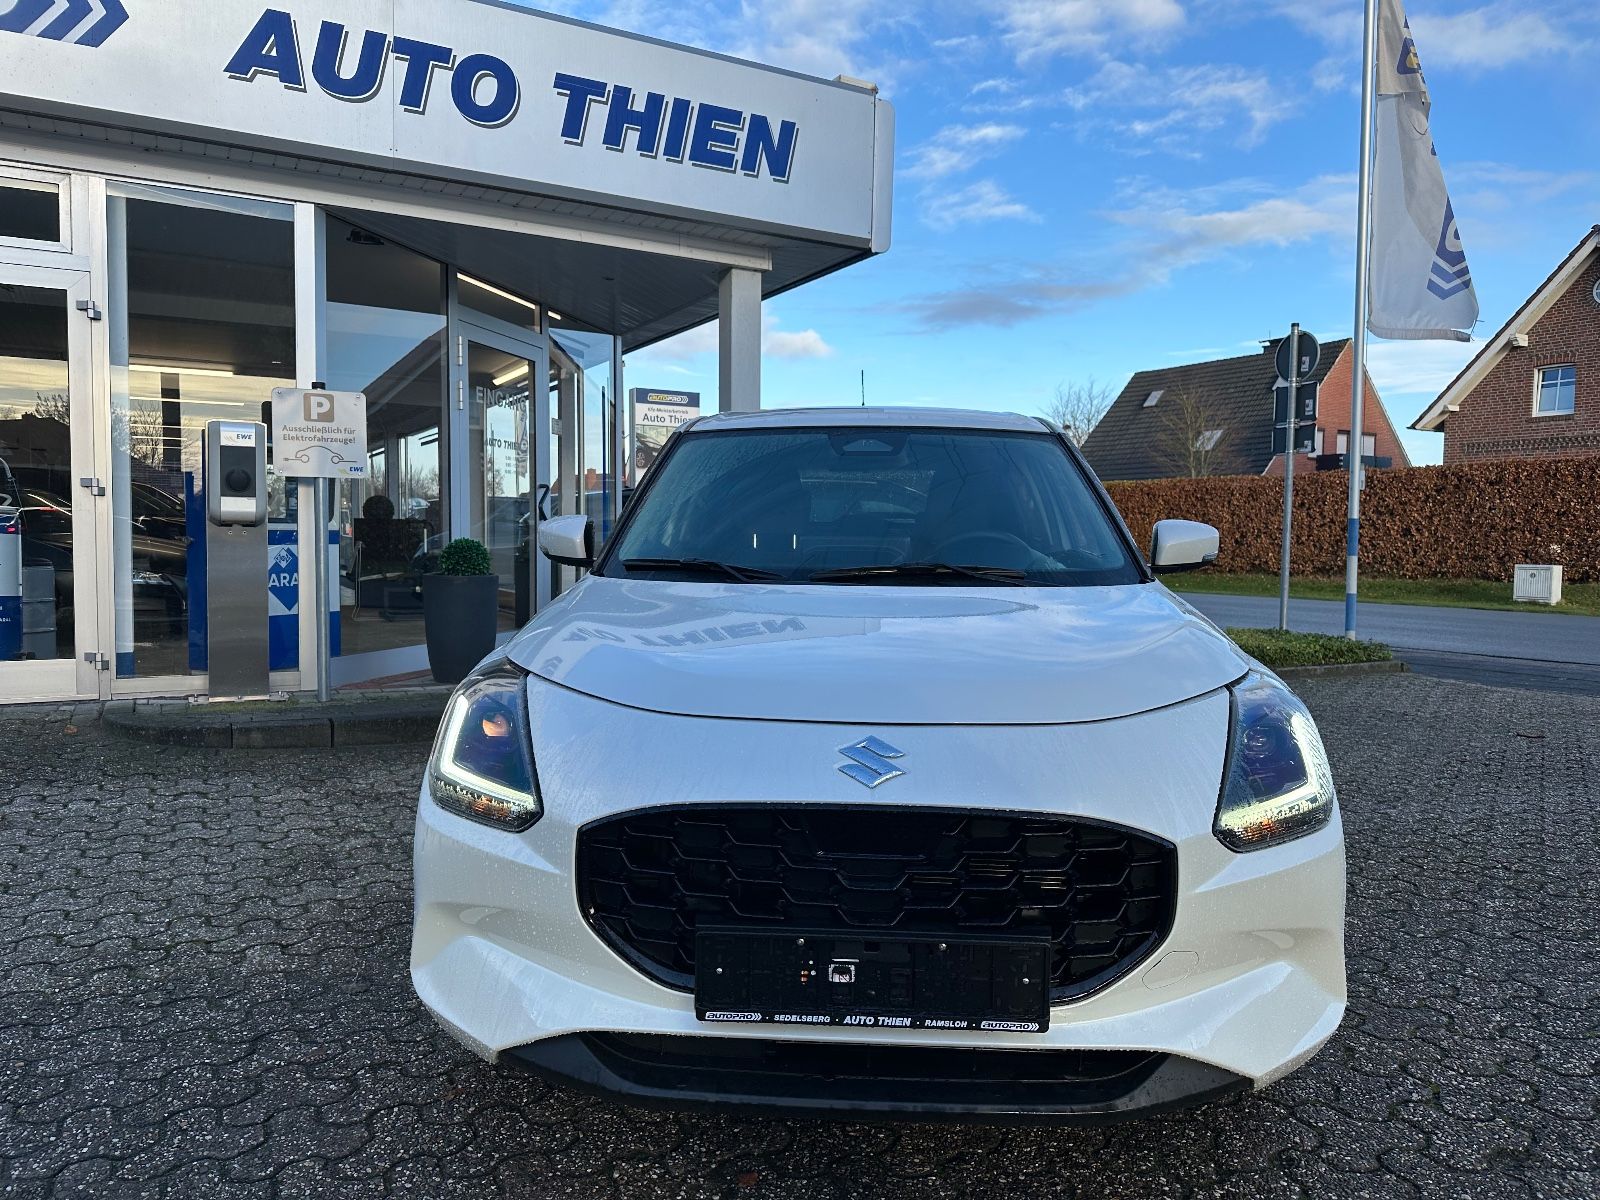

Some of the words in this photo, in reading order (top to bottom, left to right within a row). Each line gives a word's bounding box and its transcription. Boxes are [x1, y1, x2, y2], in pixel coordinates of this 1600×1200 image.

[223, 8, 521, 129] AUTO
[553, 71, 800, 182] THIEN
[310, 395, 331, 420] P
[643, 413, 666, 423] Auto
[282, 425, 342, 434] Ausschließlich
[343, 427, 356, 435] für
[282, 434, 356, 445] Elektrofahrzeuge!
[706, 1011, 754, 1021] AUTOPRO
[773, 1014, 831, 1023] SEDELSBERG
[843, 1015, 875, 1025] AUTO
[877, 1016, 912, 1027] THIEN
[924, 1019, 968, 1028] RAMSLOH
[981, 1021, 1032, 1031] AUTOPRO
